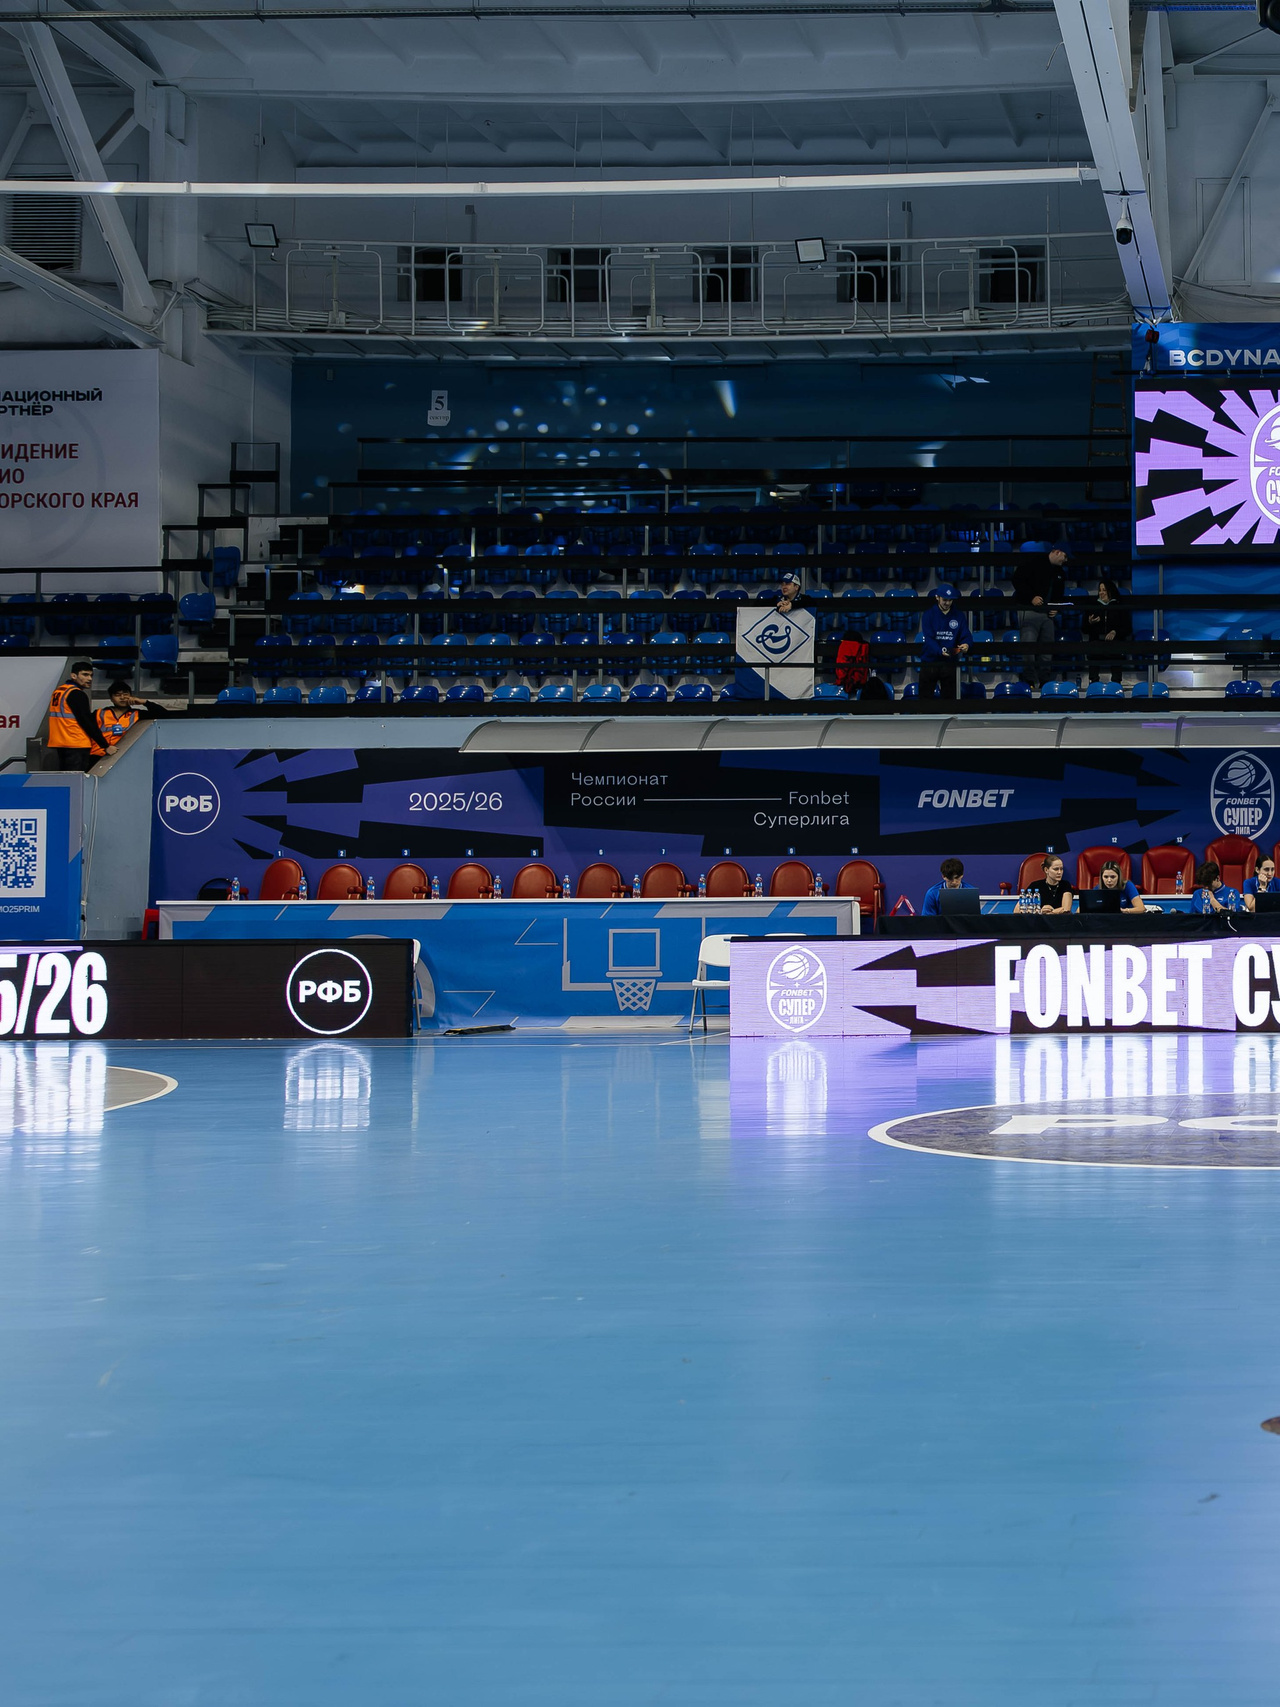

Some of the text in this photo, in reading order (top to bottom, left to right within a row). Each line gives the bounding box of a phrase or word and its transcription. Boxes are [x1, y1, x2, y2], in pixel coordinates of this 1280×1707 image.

[0, 387, 103, 403] АЦИОННЫЙ
[434, 395, 445, 411] 5
[1, 443, 79, 463] ИДЕНИЕ
[91, 492, 139, 508] КРАЯ
[571, 772, 668, 786] Чемпионат
[165, 795, 213, 813] РФБ
[409, 791, 503, 813] 2025/26
[571, 790, 850, 807] России Fonbet
[917, 789, 1015, 809] FONBET
[753, 811, 850, 829] Суперлига
[1223, 807, 1263, 826] СУПЕР
[1235, 826, 1251, 835] ЛИГА
[0, 905, 40, 914] O25PRIM
[298, 979, 362, 1003] РФБ
[780, 989, 814, 997] FONBET
[994, 943, 1213, 1028] FONBET
[778, 998, 815, 1016] СУПЕР
